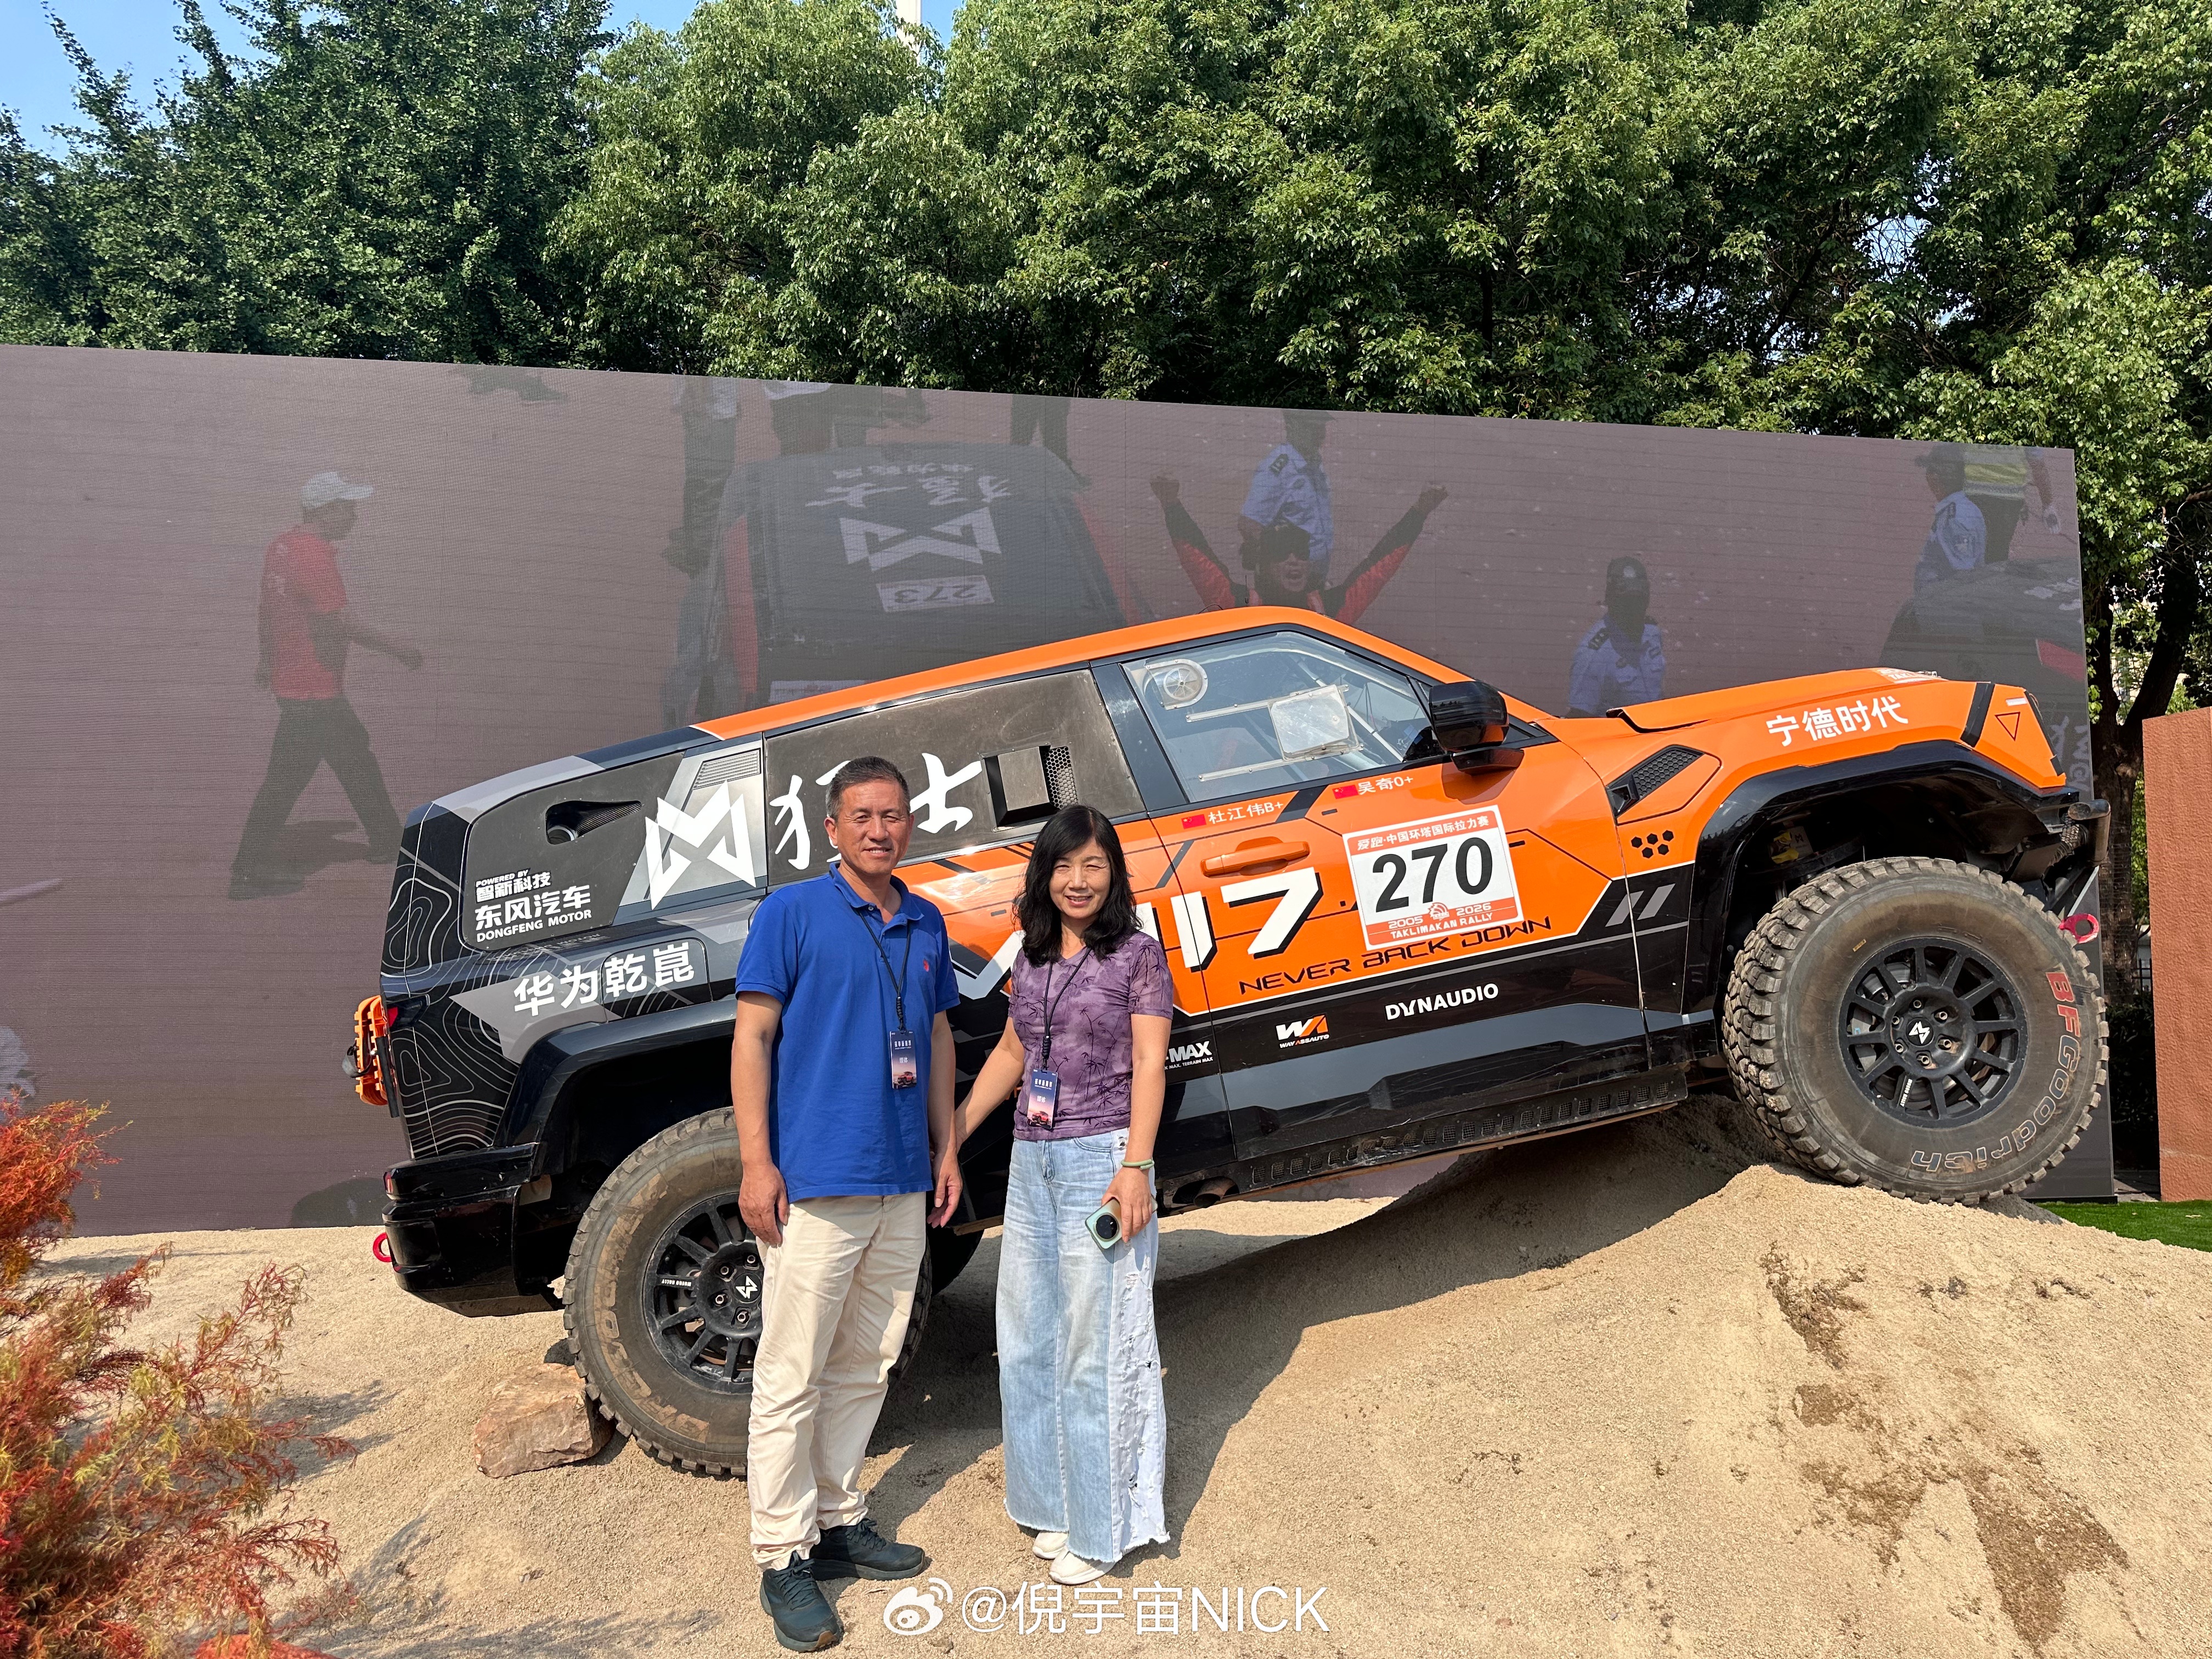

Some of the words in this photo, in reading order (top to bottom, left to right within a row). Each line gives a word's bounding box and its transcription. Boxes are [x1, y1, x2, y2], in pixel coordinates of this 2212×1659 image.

[894, 584, 977, 604] 273
[1766, 695, 1909, 747] 宁德时代
[1208, 800, 1284, 825] 杜江伟B+
[476, 873, 515, 888] POWERED
[476, 871, 551, 902] 智新科技
[1372, 837, 1493, 912] 270
[475, 884, 591, 930] 东风汽车
[1388, 916, 1423, 929] 2005
[1456, 902, 1491, 916] 2026
[477, 920, 543, 943] DONGFENG
[548, 909, 592, 927] MOTOR
[1390, 919, 1457, 939] TAKLIMAKAN
[1460, 912, 1493, 926] RALLY
[1239, 958, 1350, 995] NEVER
[1362, 937, 1451, 969] BACK
[1461, 916, 1551, 948] DOWN
[514, 942, 695, 1017] 华为乾崑
[1385, 983, 1499, 1020] DYNAUDIO
[1910, 971, 2081, 1173] BFGoodrich
